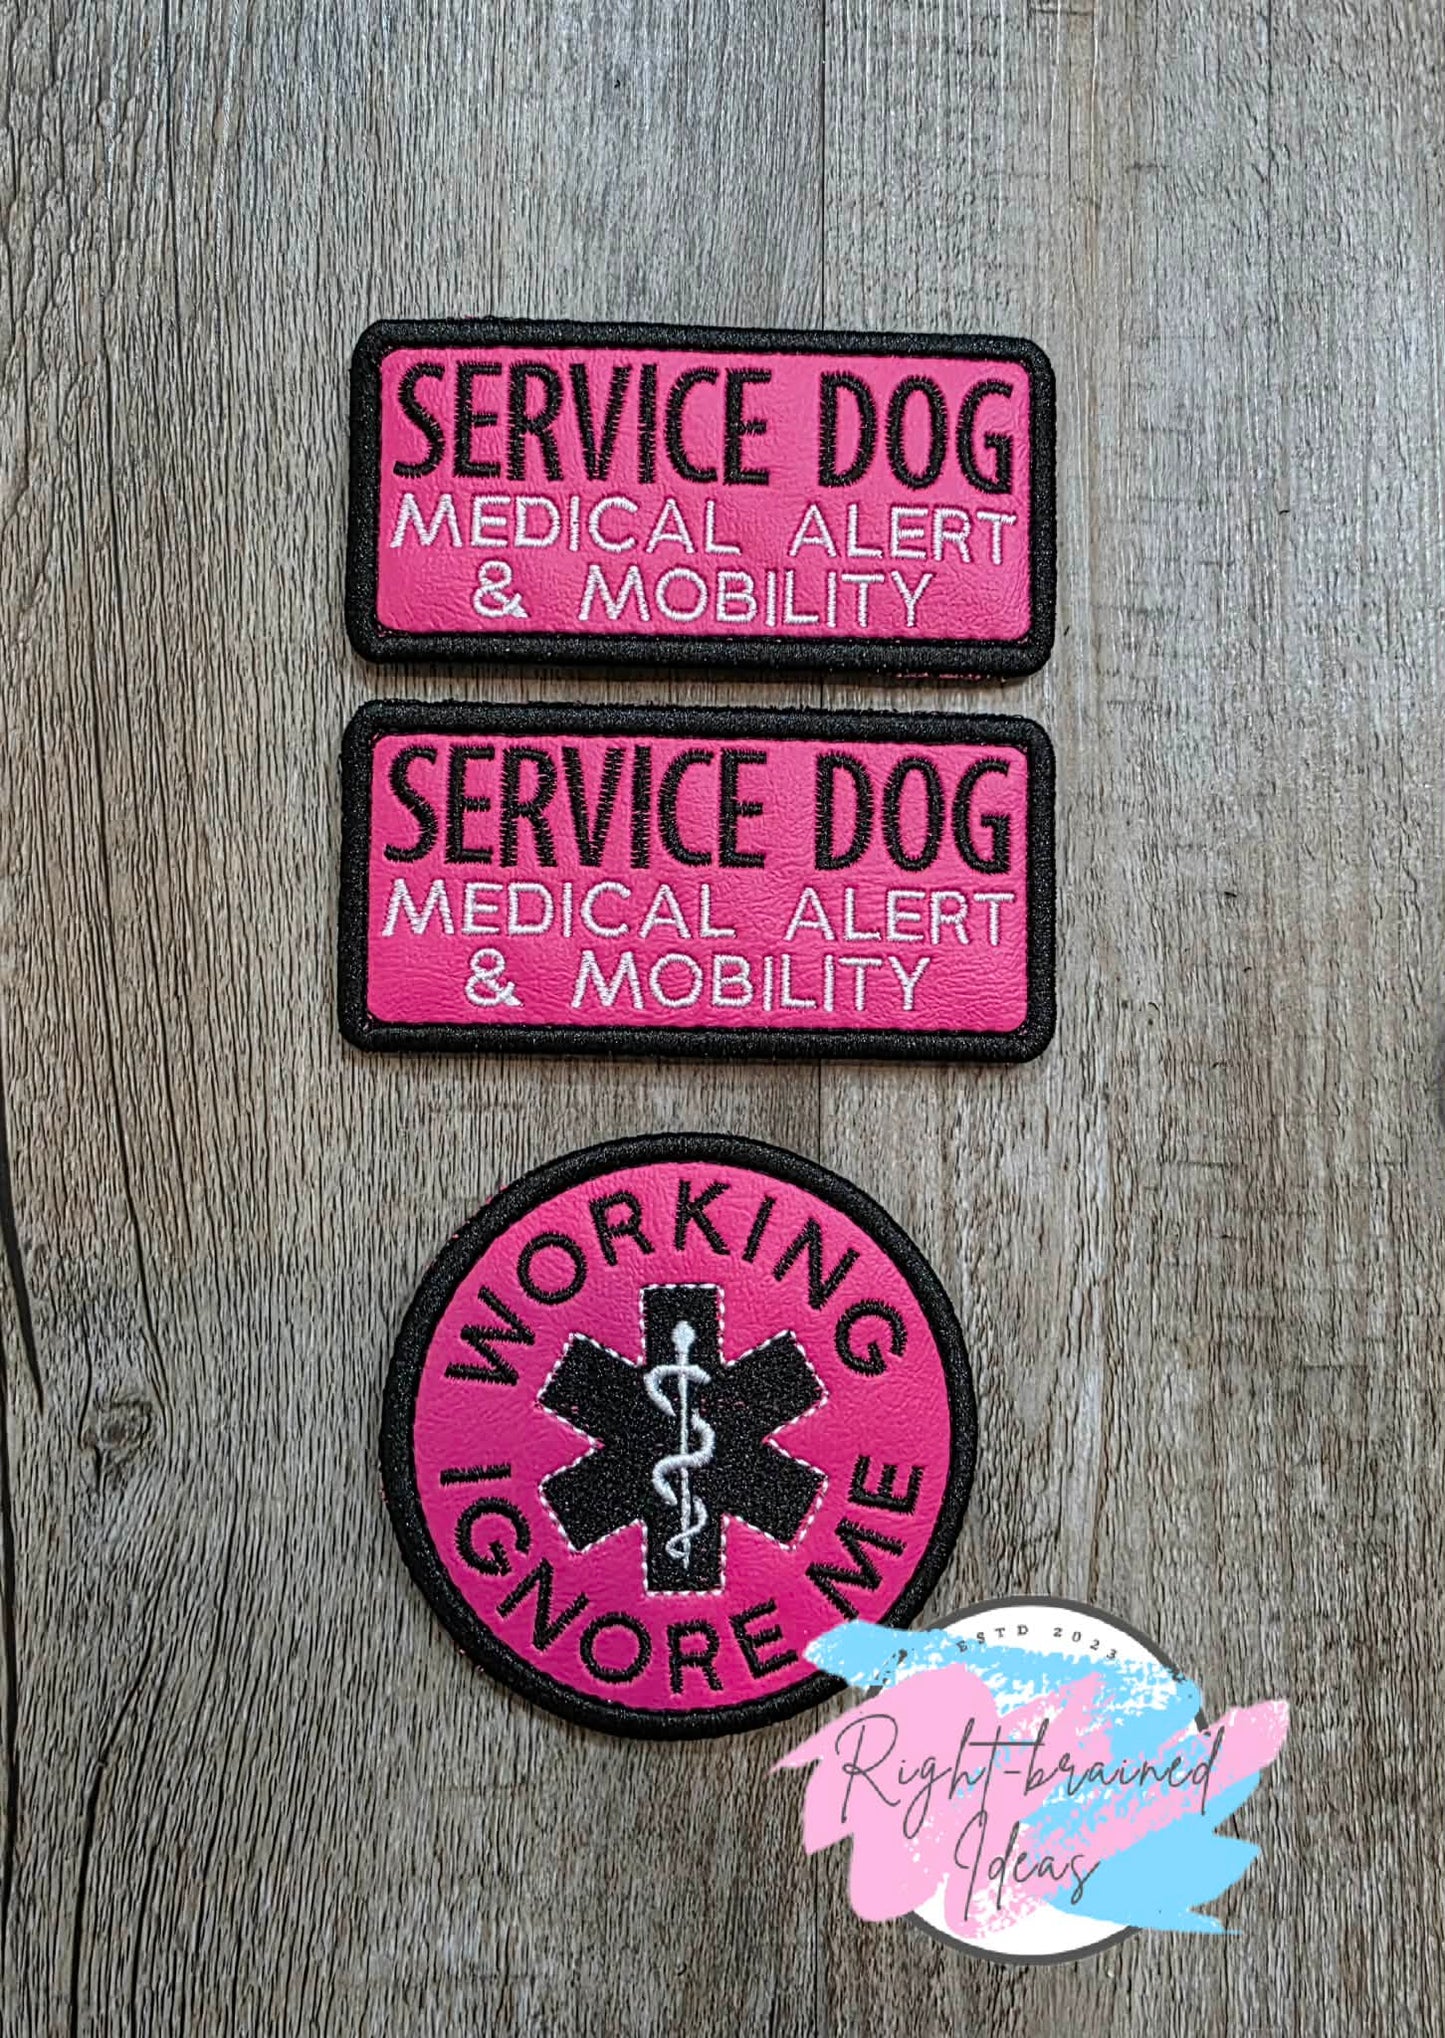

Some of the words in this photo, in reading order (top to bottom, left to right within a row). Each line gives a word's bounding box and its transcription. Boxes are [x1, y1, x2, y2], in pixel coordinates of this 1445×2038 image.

[392, 360, 772, 486] SERVICE
[818, 370, 1016, 495] DOG
[389, 492, 741, 557] MEDICAL
[788, 503, 1017, 565] ALERT
[472, 560, 527, 619] &
[578, 564, 935, 628] MOBILITY
[382, 743, 768, 870] SERVICE
[813, 750, 1012, 875] DOG
[381, 878, 736, 940] MEDICAL
[783, 887, 1016, 947] ALERT
[464, 948, 523, 1008] &
[570, 950, 933, 1013] MOBILITY
[445, 1179, 908, 1387] WORKING
[440, 1463, 798, 1694] IGNORE
[805, 1455, 927, 1621] ME
